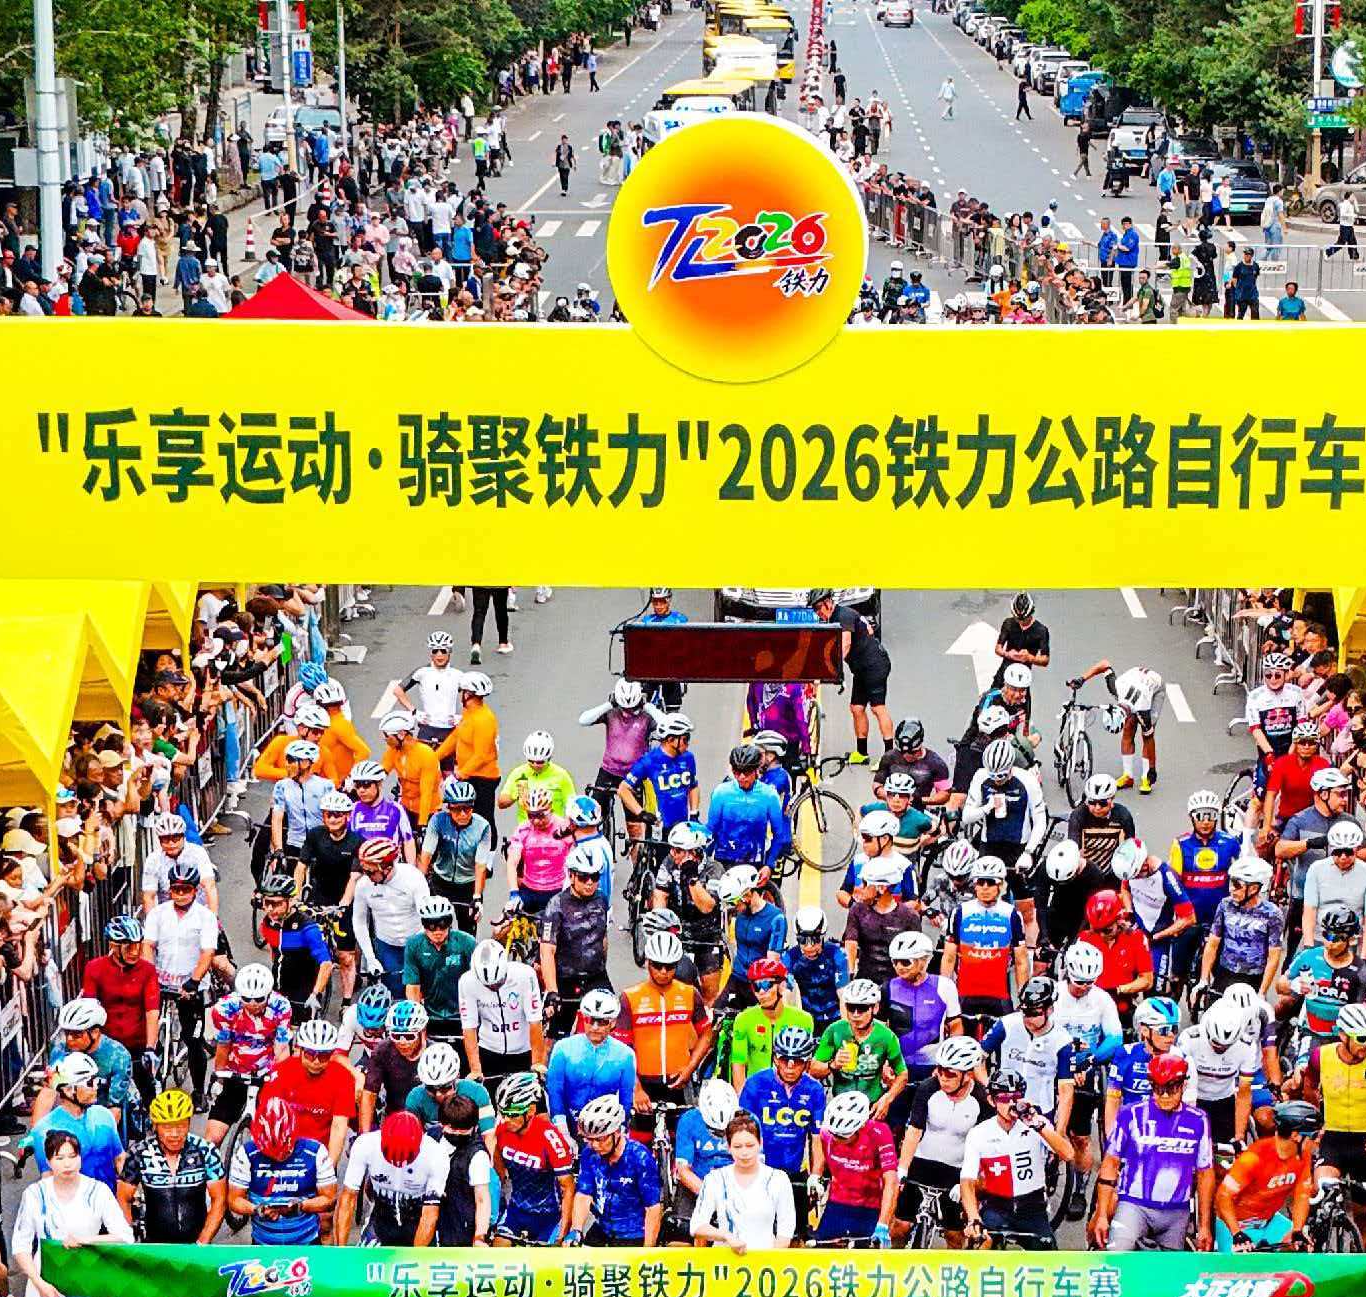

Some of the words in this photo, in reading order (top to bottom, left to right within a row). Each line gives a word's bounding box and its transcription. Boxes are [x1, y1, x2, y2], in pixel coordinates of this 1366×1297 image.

[773, 266, 830, 297] 铁力
[657, 771, 691, 791] LCC
[762, 1106, 811, 1127] LCC
